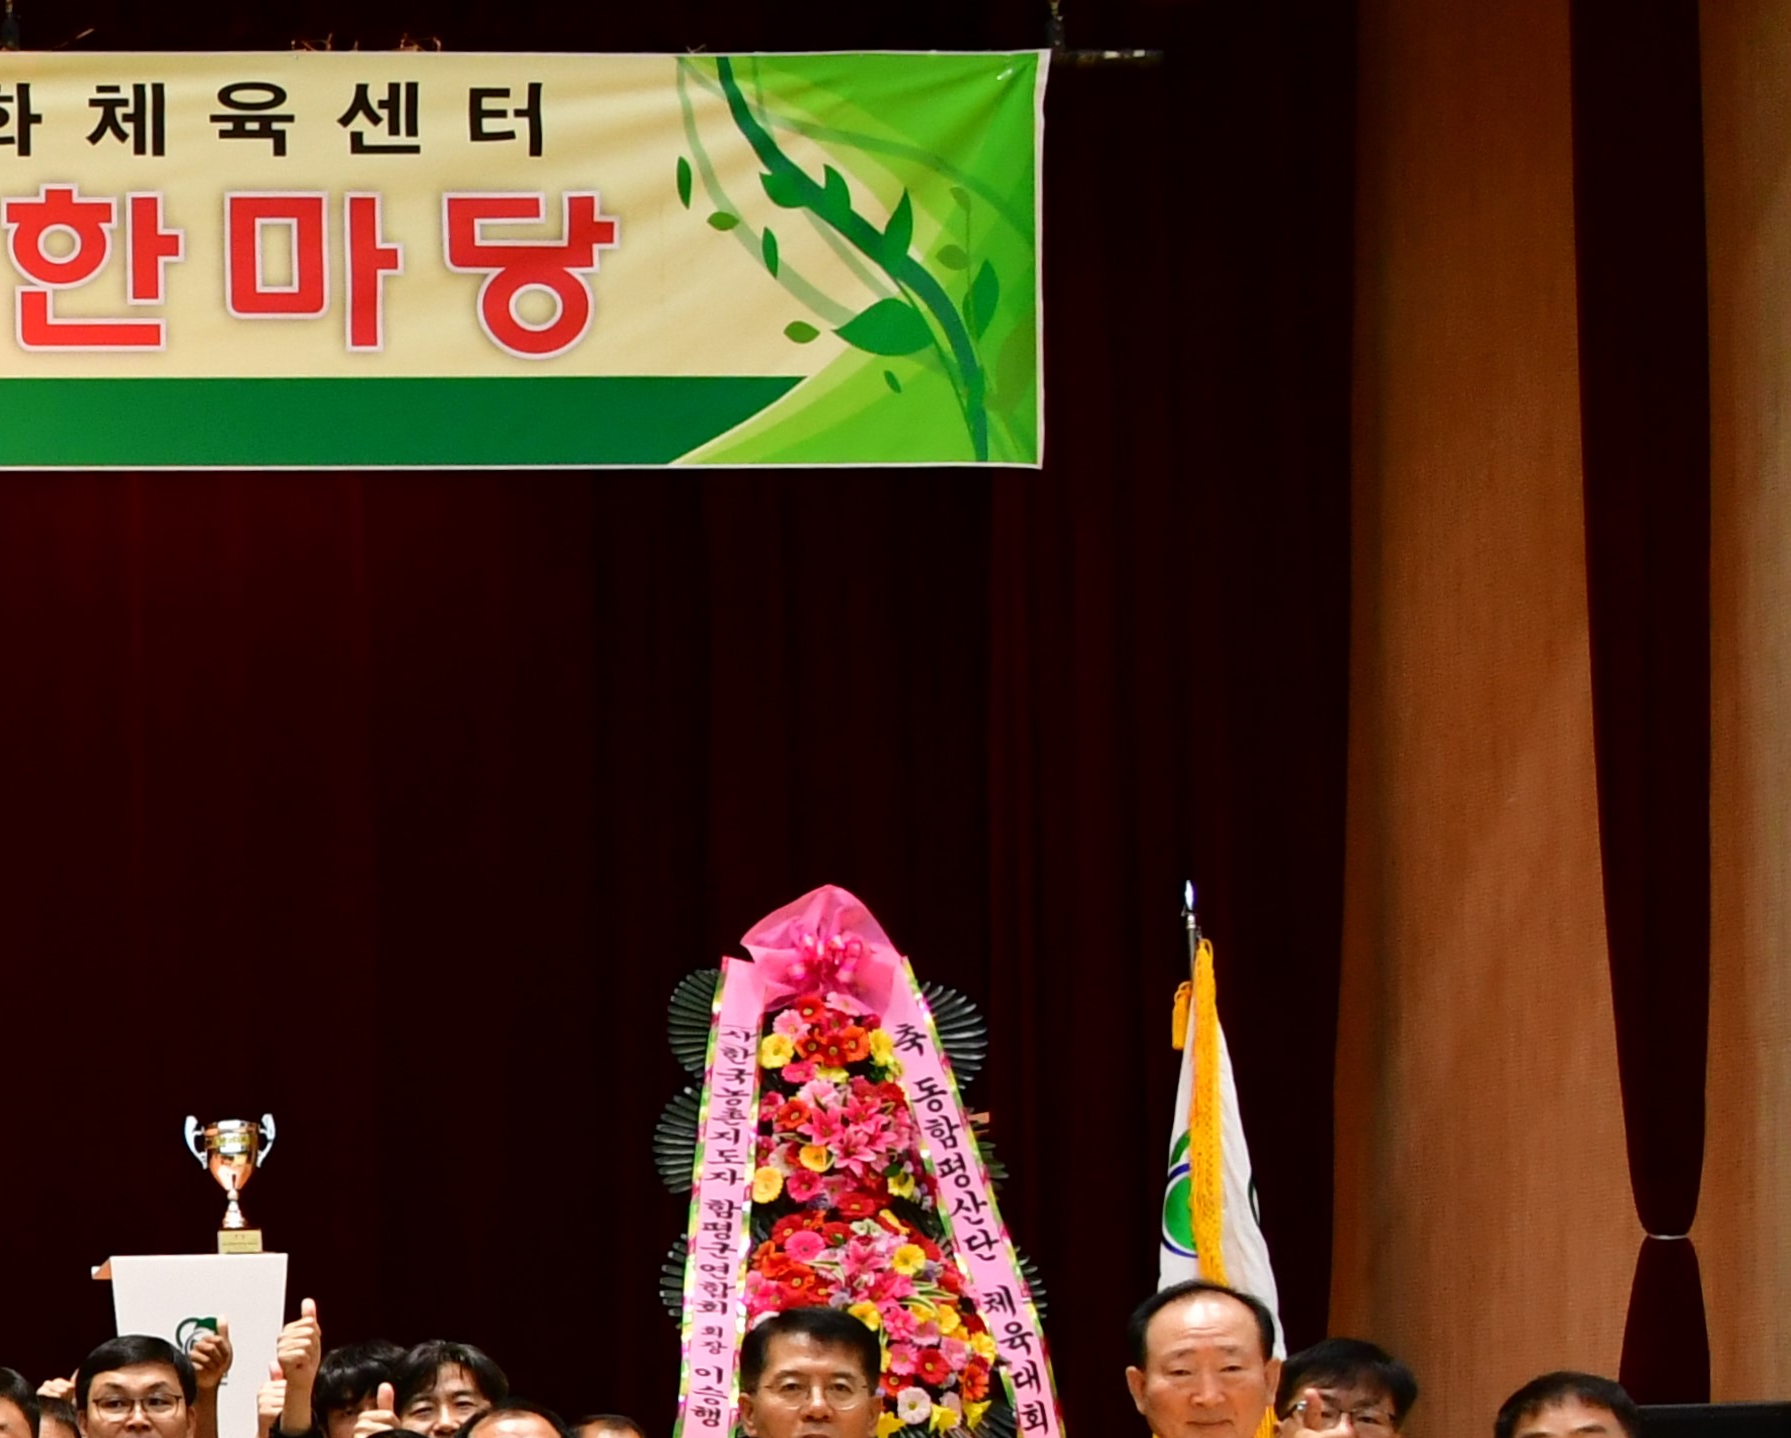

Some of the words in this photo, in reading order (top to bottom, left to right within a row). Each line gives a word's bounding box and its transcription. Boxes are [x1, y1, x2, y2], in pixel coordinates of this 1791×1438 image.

[2, 184, 621, 357] 한마당
[893, 1022, 929, 1057] 축
[909, 1076, 999, 1262] 동함평산단
[696, 1199, 742, 1315] 함평군연합회
[700, 1326, 729, 1355] 회장
[980, 1284, 1049, 1436] 체육대회
